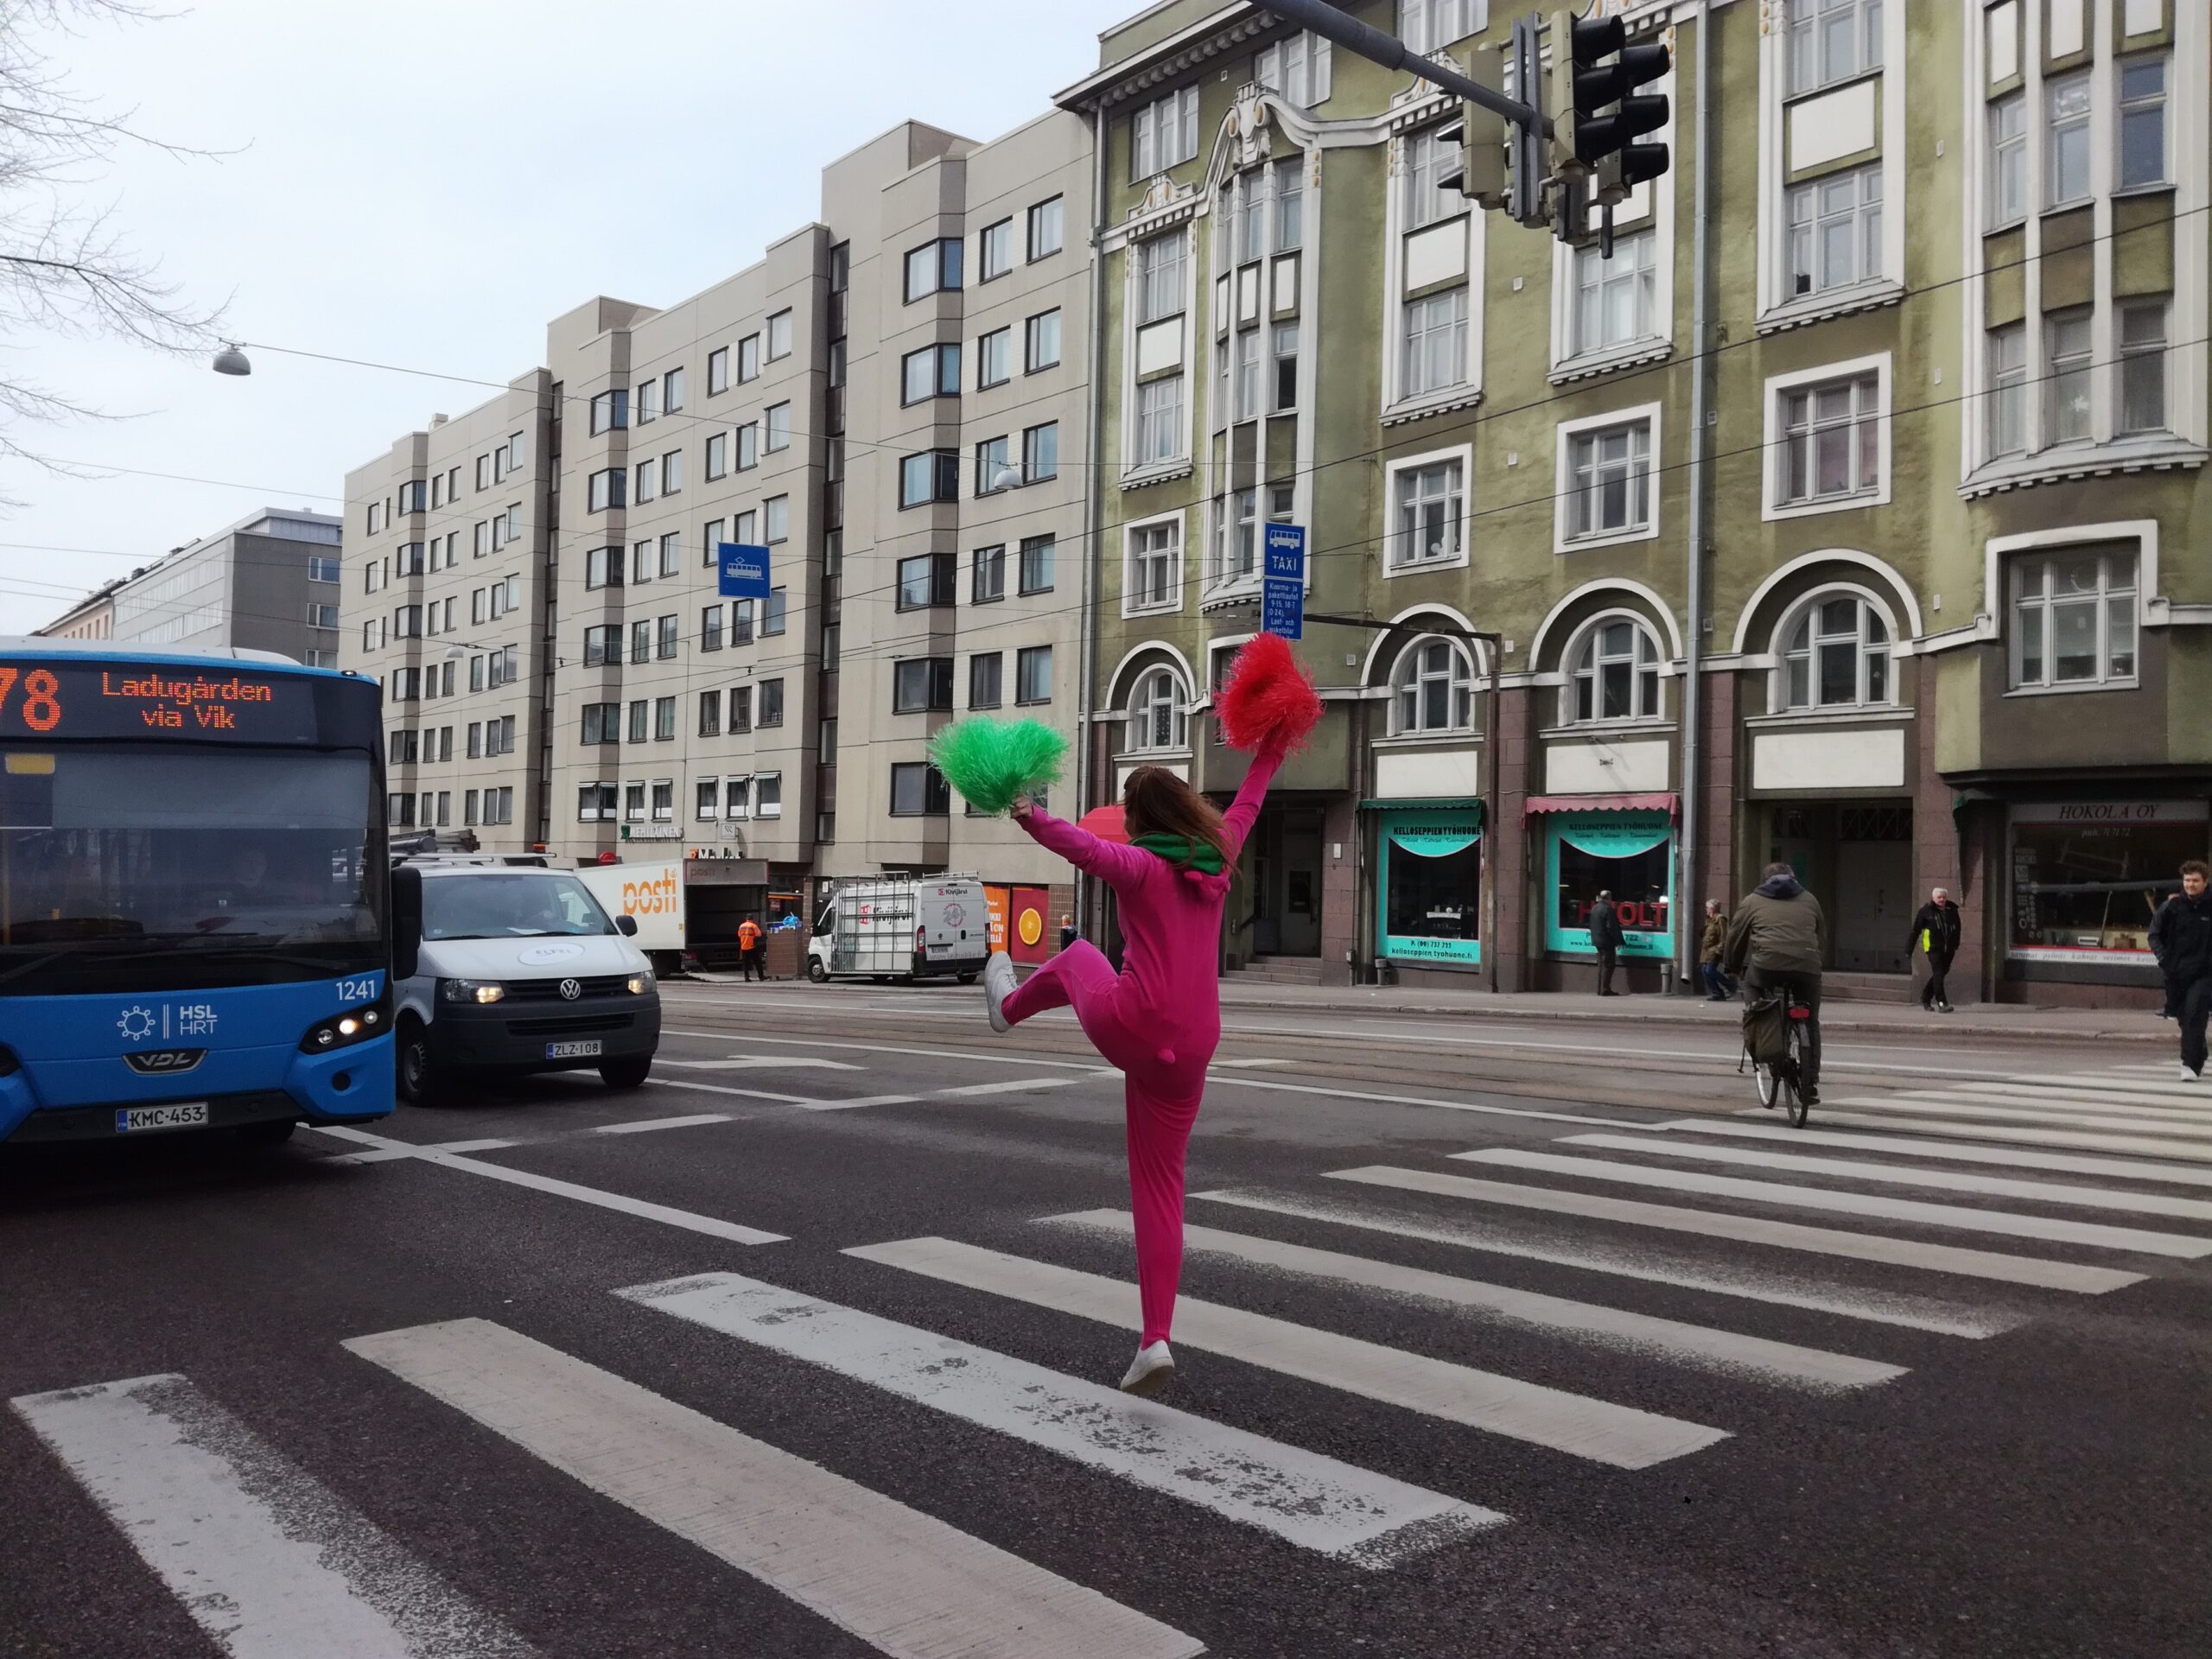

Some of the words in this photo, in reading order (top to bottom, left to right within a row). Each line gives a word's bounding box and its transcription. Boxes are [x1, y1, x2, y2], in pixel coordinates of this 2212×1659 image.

[1272, 556, 1297, 571] TAXI
[1292, 584, 1298, 593] ja
[102, 671, 272, 705] Ladugården
[142, 703, 184, 727] via
[194, 704, 235, 728] Vik
[2059, 804, 2129, 819] HOKOLA
[2136, 804, 2158, 818] OY
[690, 868, 715, 877] posti
[623, 868, 677, 915] posti
[1577, 900, 1669, 926] HOLT
[335, 980, 375, 1001] 1241
[180, 1004, 218, 1020] HSL
[180, 1020, 218, 1035] HRT
[555, 1043, 599, 1056] ZLZ-108
[137, 1053, 191, 1066] VDL
[130, 1106, 203, 1125] KMC-453
